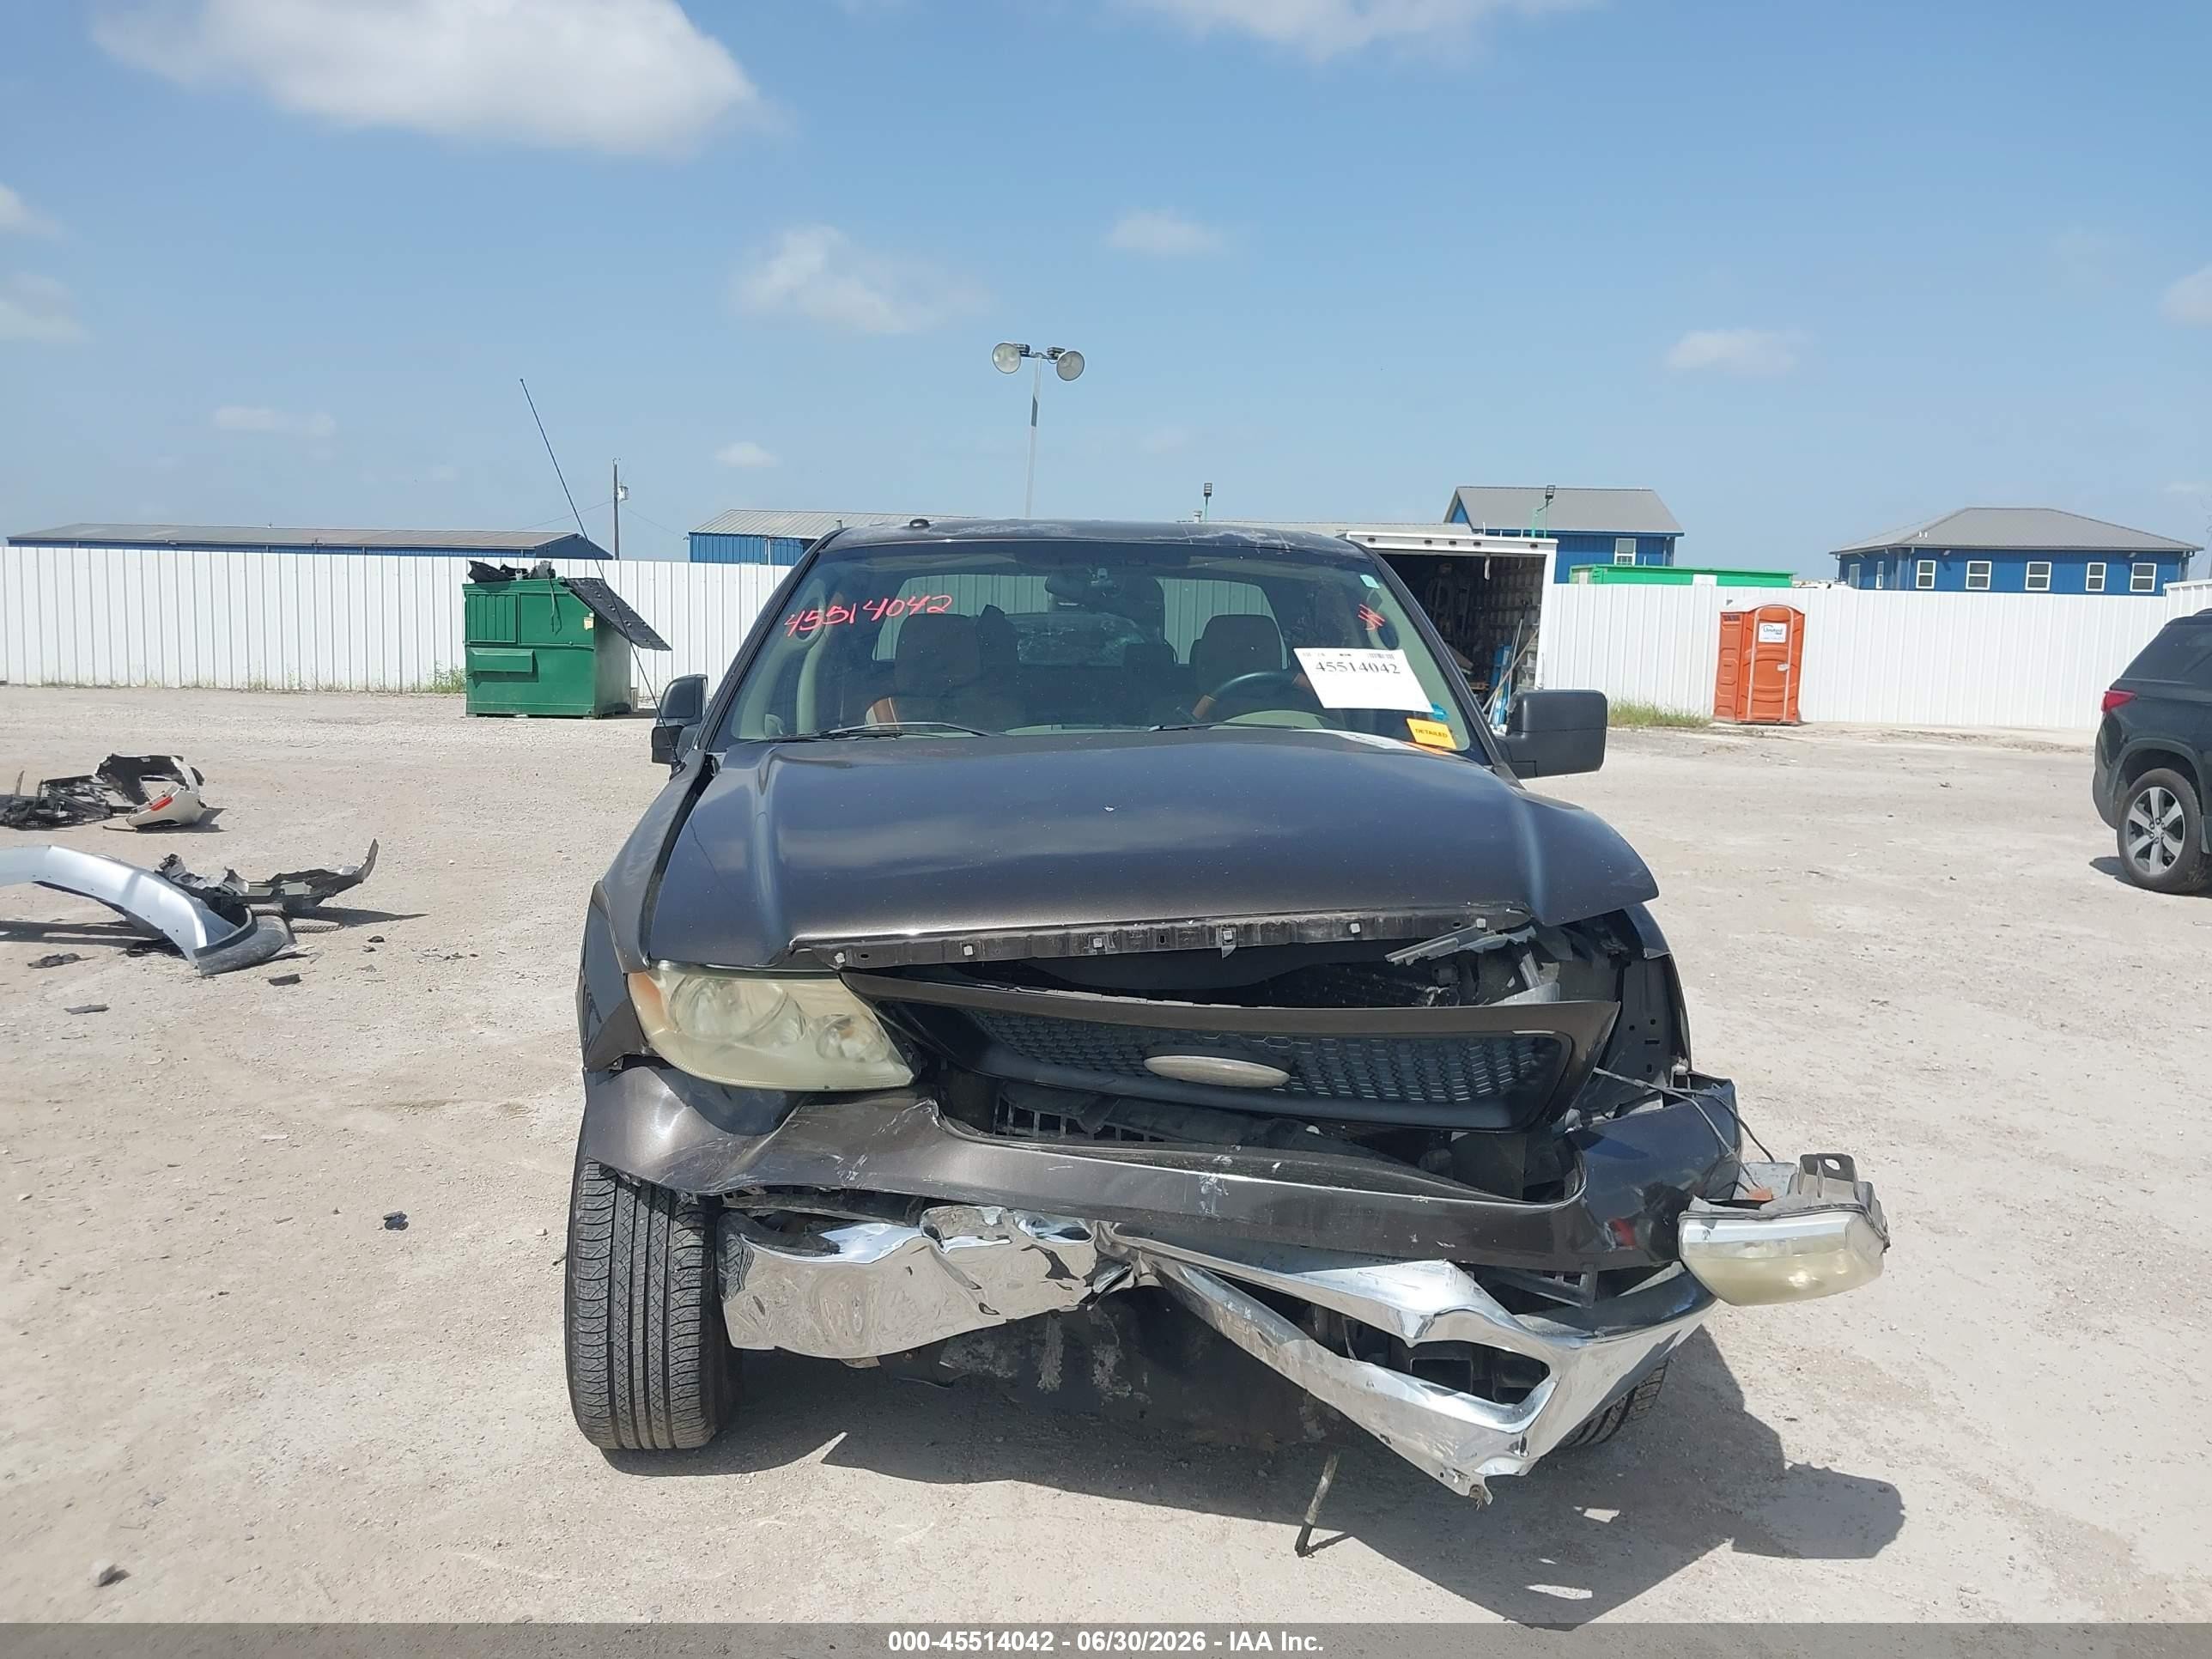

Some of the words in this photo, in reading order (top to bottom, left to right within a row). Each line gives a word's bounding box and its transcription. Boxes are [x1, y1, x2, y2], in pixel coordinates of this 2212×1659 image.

[784, 594, 953, 637] 45514042
[1316, 661, 1401, 674] 45514042
[1414, 728, 1448, 738] DETAILED
